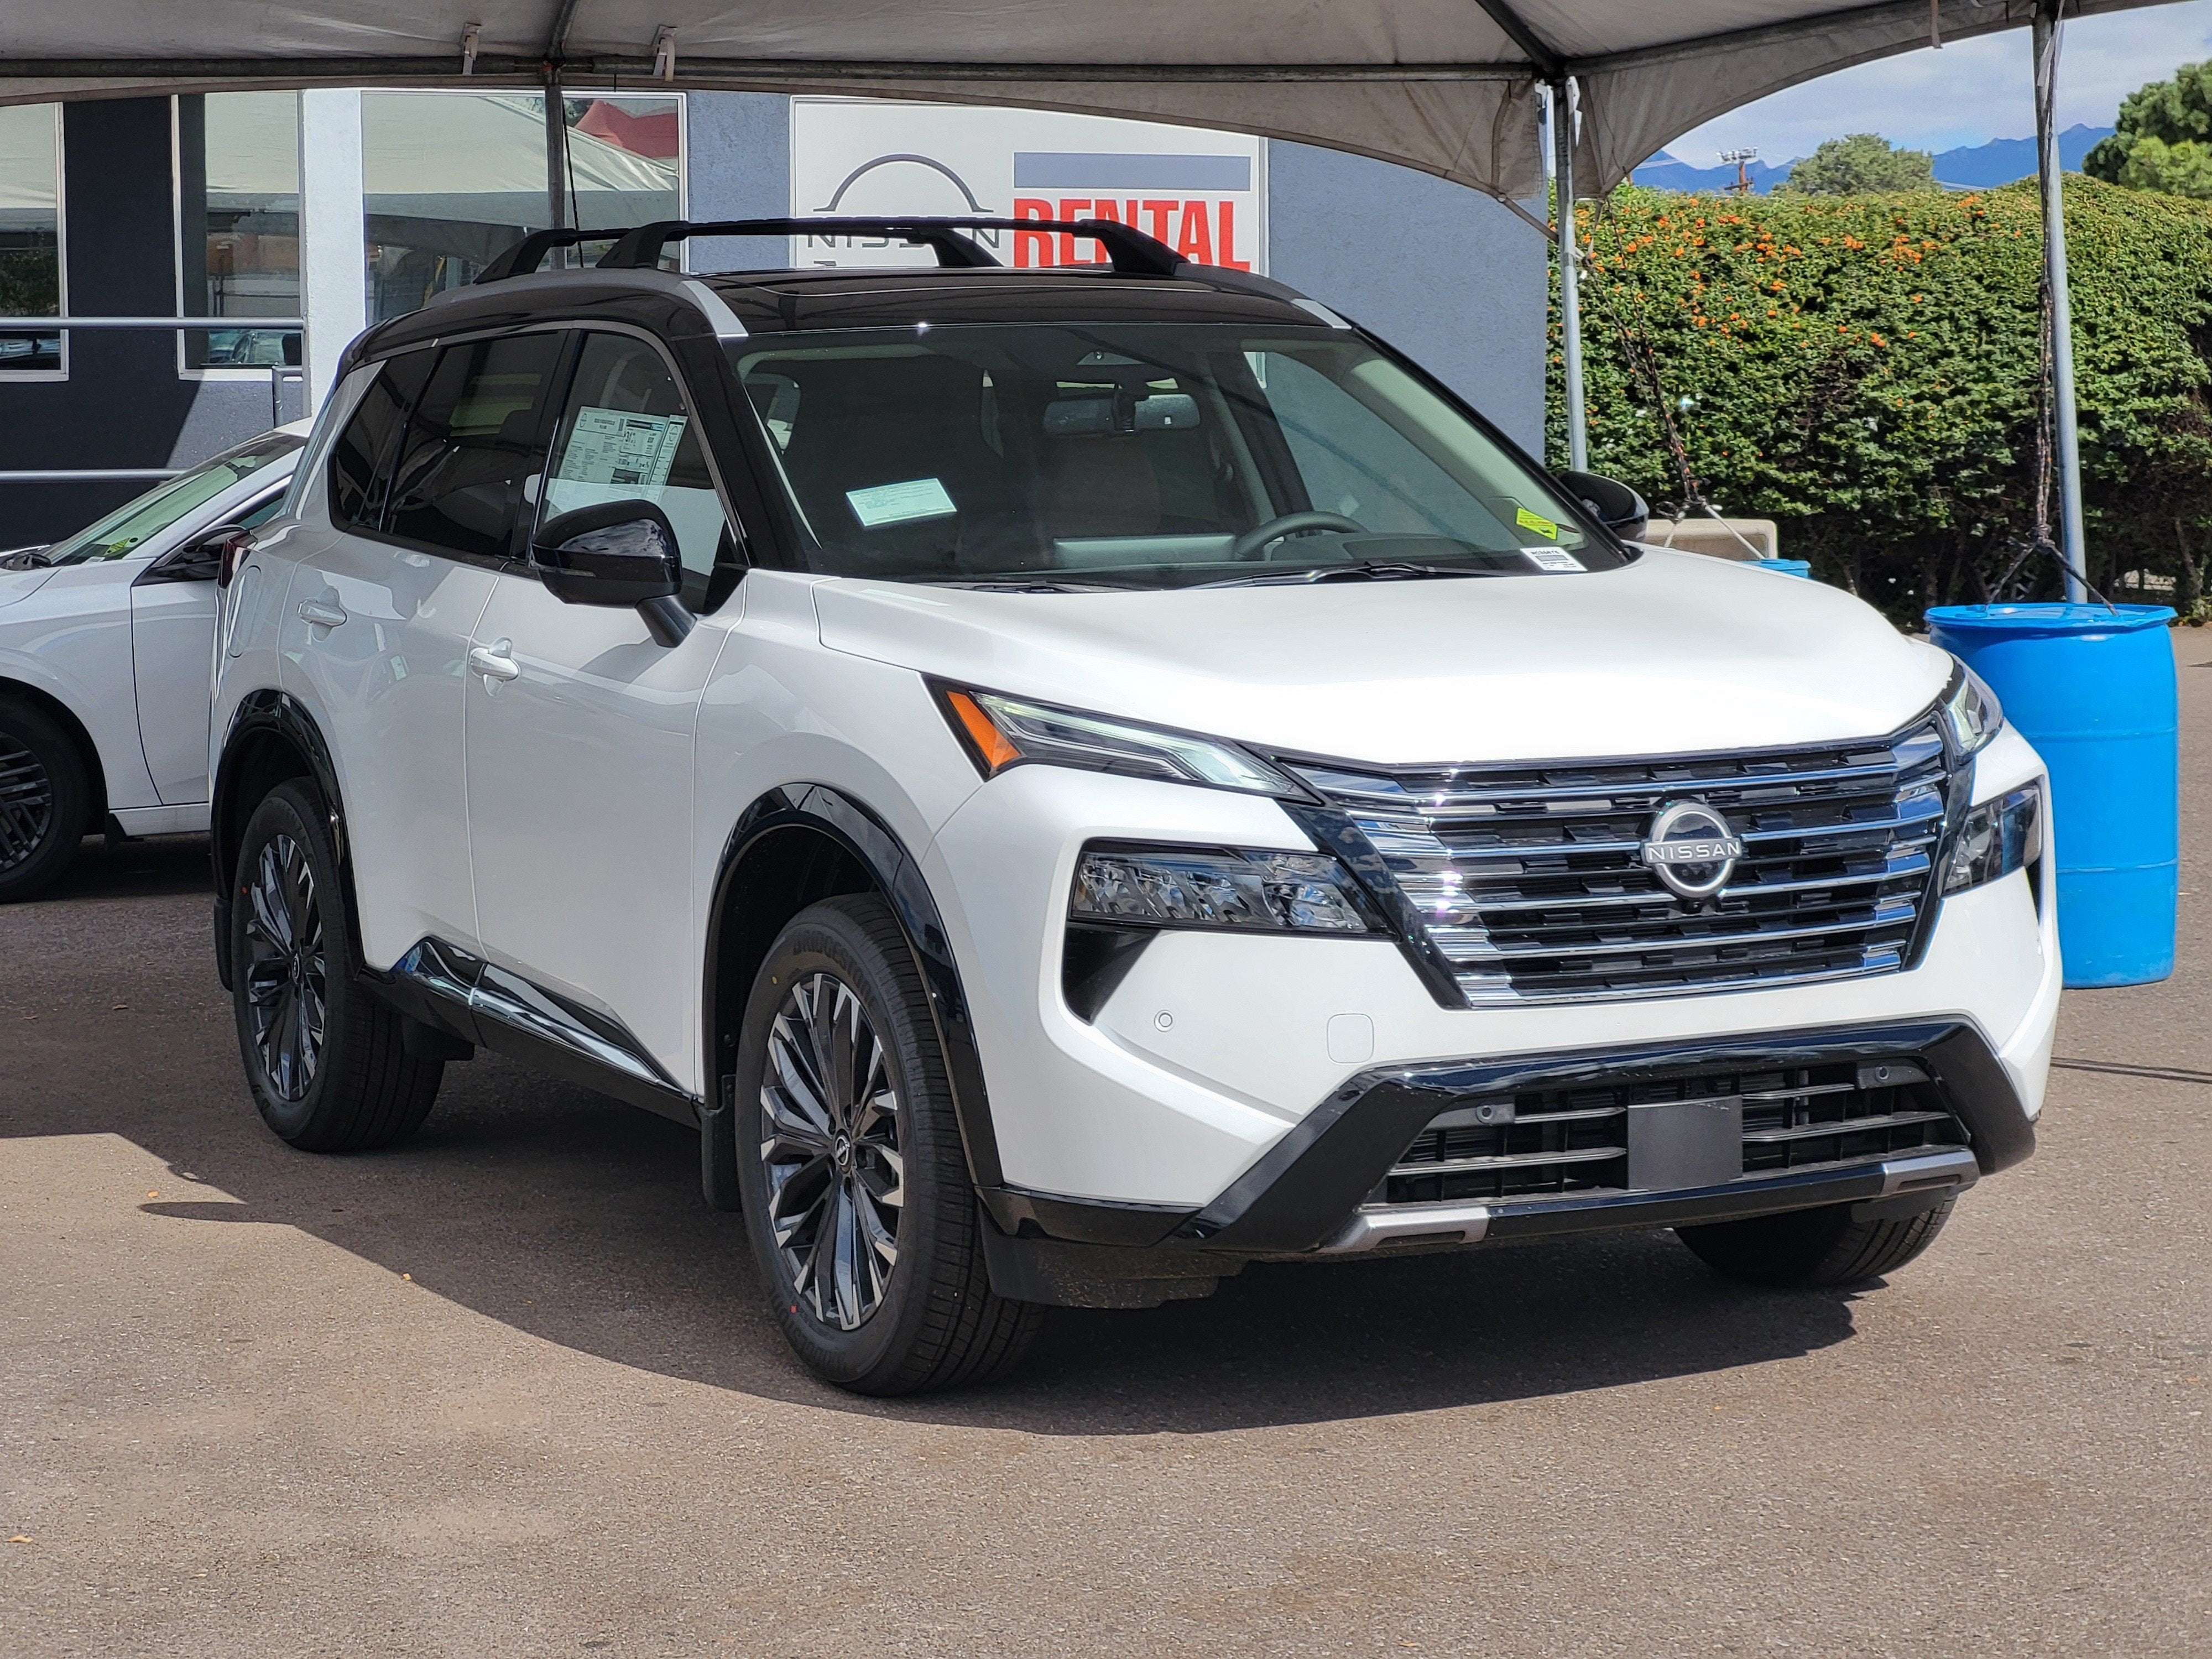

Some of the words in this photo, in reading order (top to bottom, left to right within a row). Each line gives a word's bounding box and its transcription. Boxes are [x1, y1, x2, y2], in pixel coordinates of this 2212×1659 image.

[1014, 198, 1250, 272] RENTAL
[1648, 842, 1741, 860] NISSAN
[792, 930, 877, 1011] BRIDGESTONE
